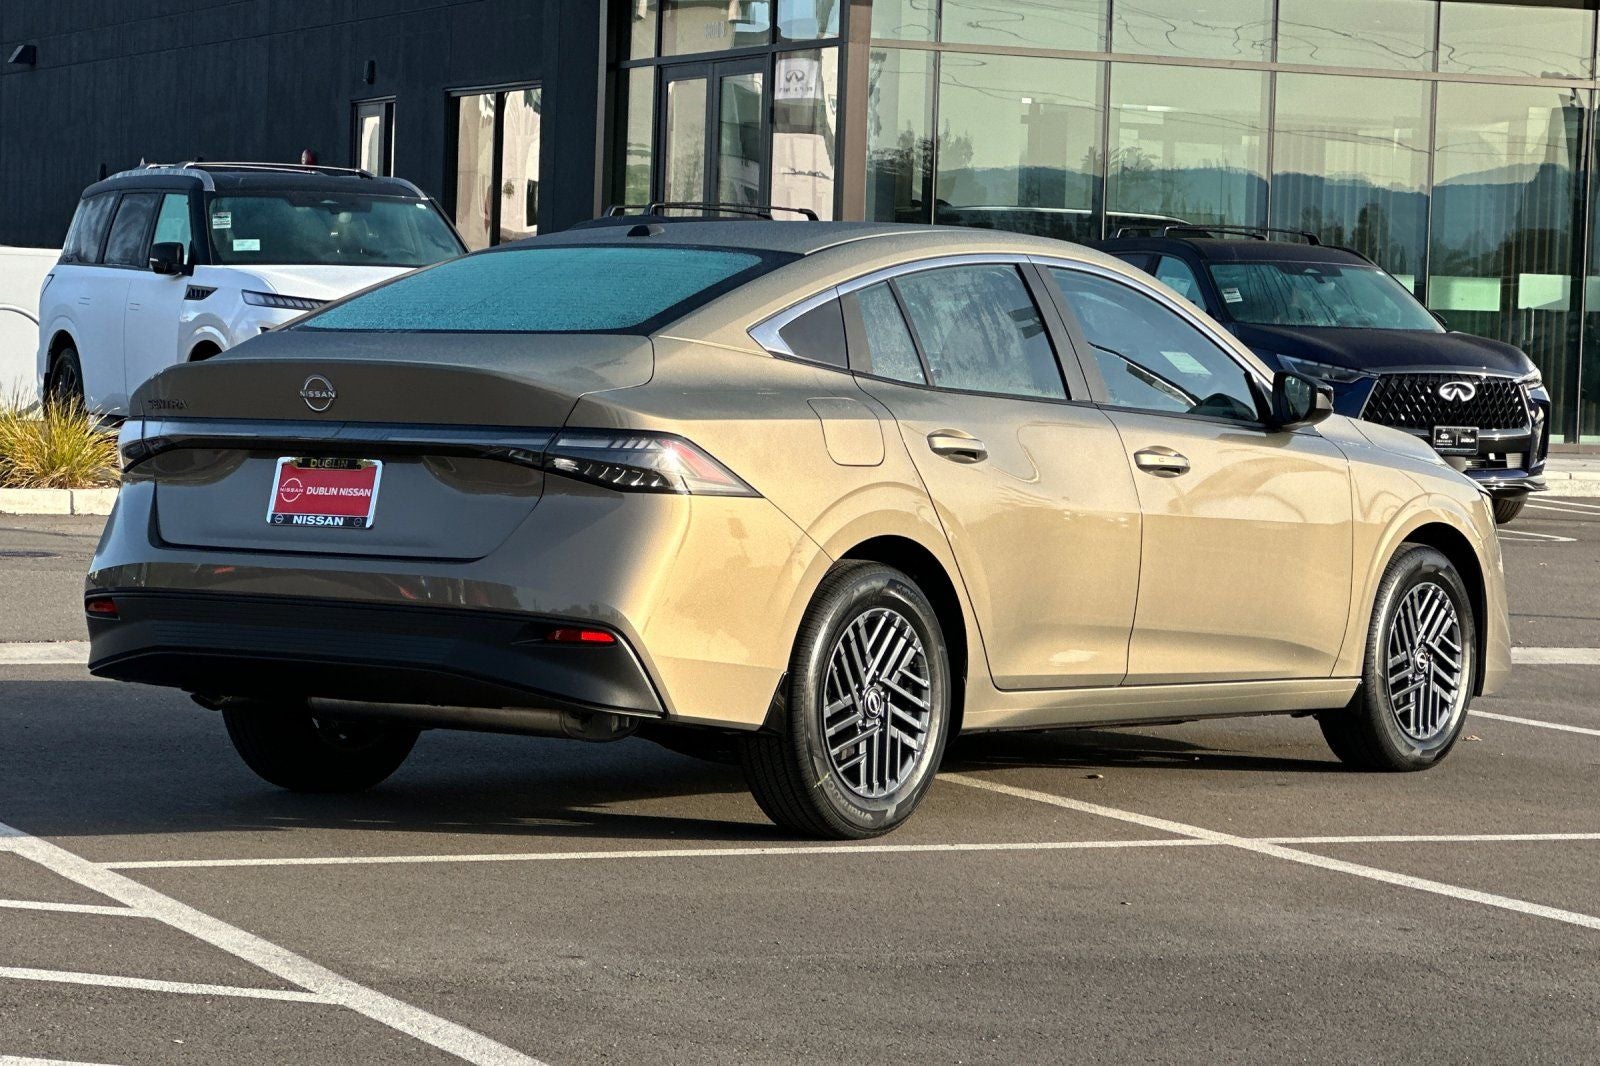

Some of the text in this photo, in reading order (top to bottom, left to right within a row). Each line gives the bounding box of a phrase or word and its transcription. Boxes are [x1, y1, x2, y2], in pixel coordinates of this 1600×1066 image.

[300, 390, 336, 398] NISSAN
[310, 458, 348, 468] DUBLIN
[306, 486, 371, 497] DUBLIN NISSAN
[292, 515, 344, 526] NISSAN
